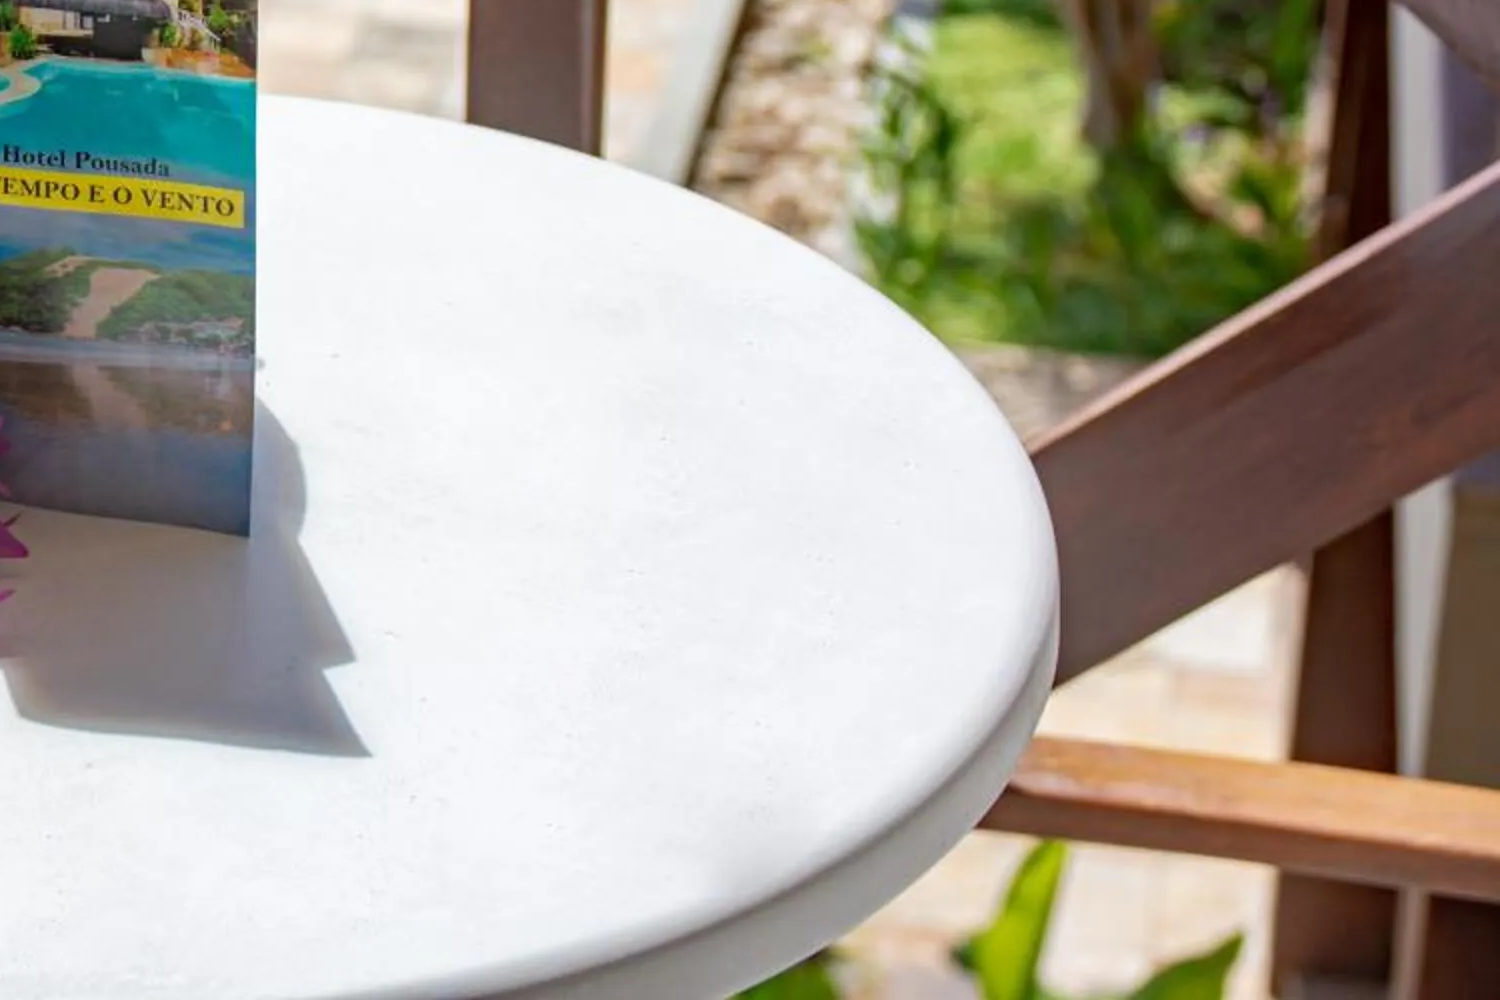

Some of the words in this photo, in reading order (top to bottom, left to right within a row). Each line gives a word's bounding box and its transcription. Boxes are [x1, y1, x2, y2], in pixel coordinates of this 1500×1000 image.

[3, 144, 66, 168] Hotel
[75, 150, 170, 177] Pousada
[89, 185, 105, 203] E
[113, 186, 133, 205] O
[141, 189, 235, 217] VENTO
